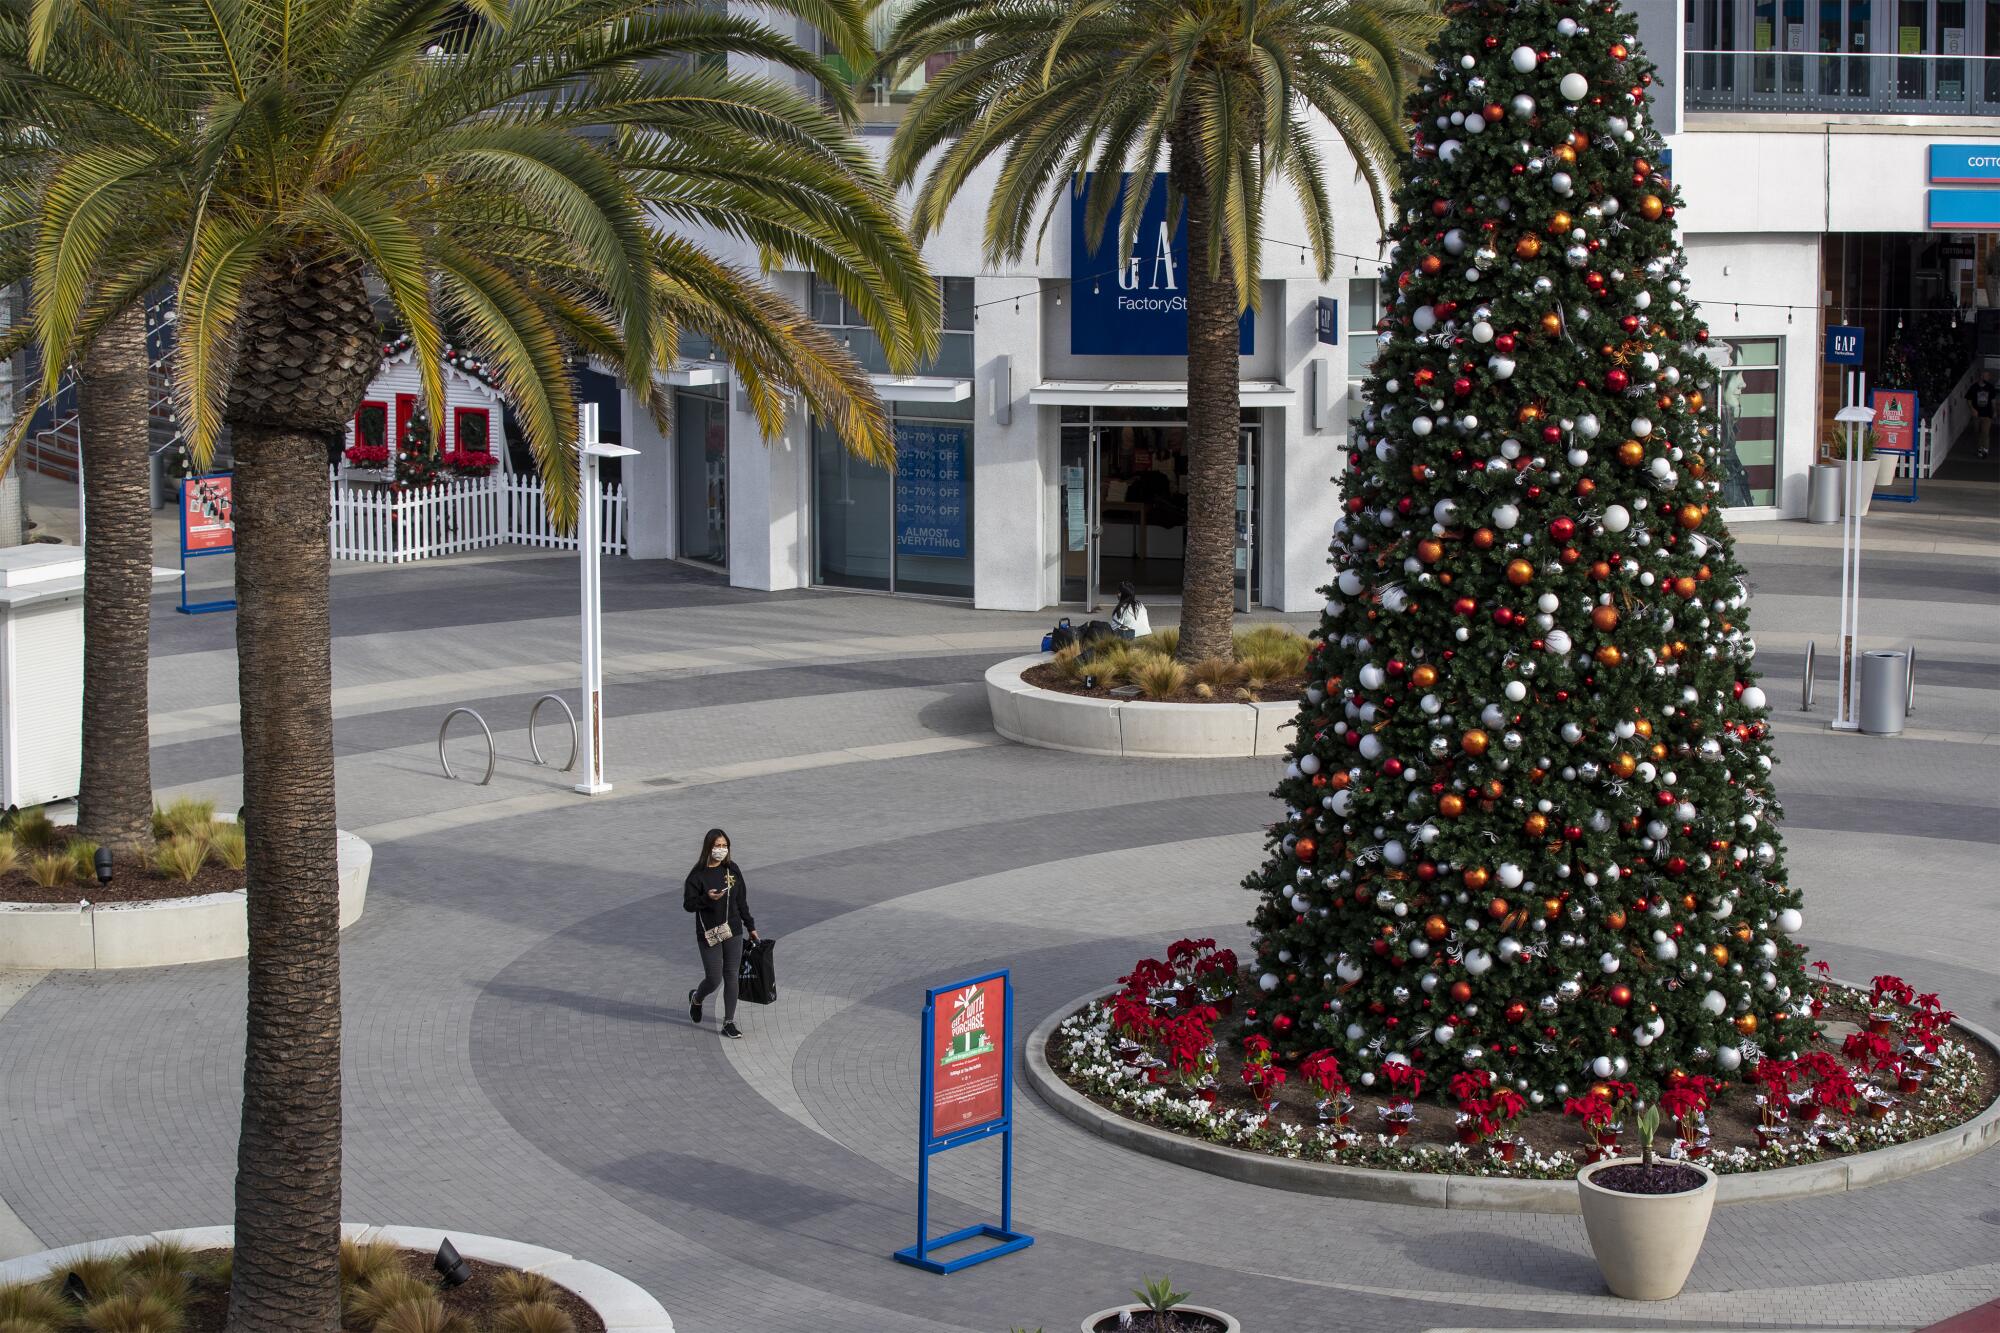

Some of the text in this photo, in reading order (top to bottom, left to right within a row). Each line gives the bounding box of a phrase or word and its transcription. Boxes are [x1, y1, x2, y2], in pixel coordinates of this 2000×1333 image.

[1118, 221, 1179, 290] GA
[1118, 296, 1187, 313] FactorySt
[1835, 335, 1856, 352] GAP
[939, 433, 959, 443] OFF
[939, 451, 959, 462] OFF
[939, 470, 960, 480] OFF
[940, 488, 960, 498] OFF
[940, 506, 960, 516] OFF
[905, 527, 949, 538] ALMOST
[897, 535, 961, 548] EVERYTHING
[951, 992, 985, 1029] GIFT WITH
[951, 1012, 985, 1037] PURCHASE
